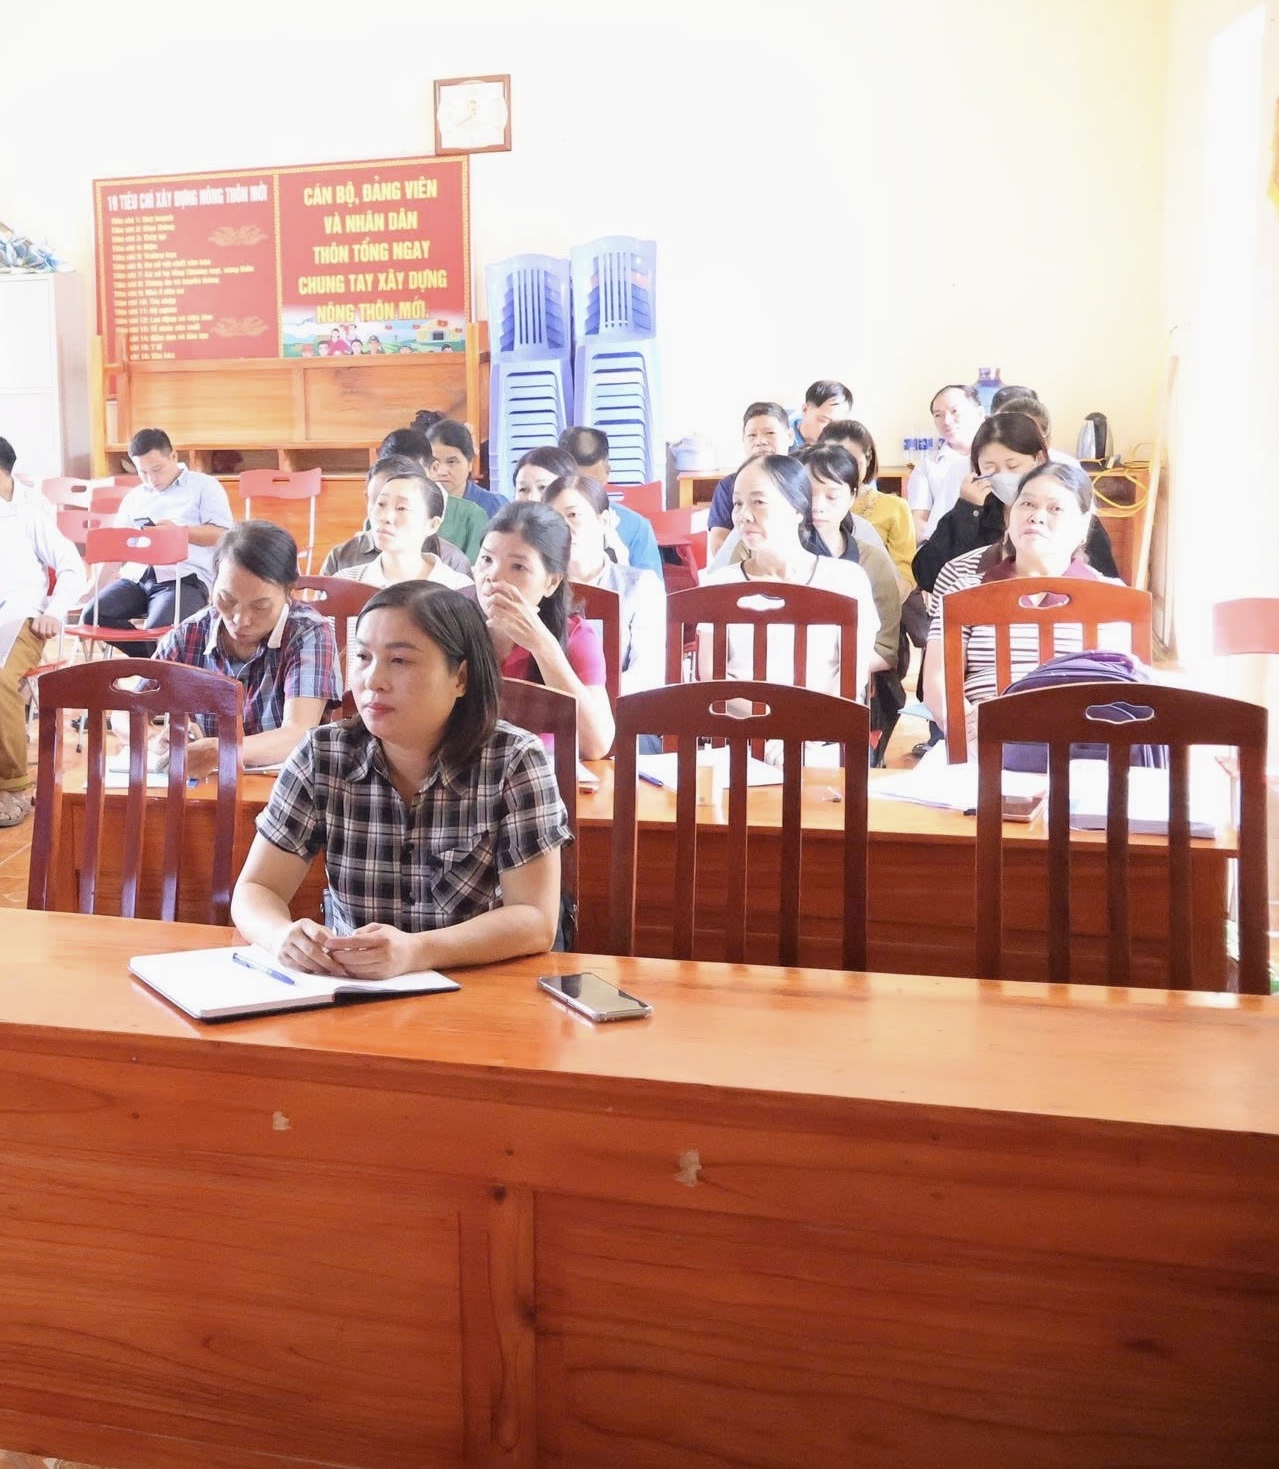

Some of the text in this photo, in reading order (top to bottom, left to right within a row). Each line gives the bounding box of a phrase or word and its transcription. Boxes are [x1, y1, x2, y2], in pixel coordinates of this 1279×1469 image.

[107, 194, 118, 211] 19
[303, 175, 438, 207] CÁN BỘ, ĐẢNG VIÊN
[324, 207, 418, 234] VÀ NHÂN DÂN
[313, 241, 349, 265] THÔN
[392, 240, 431, 260] NGAY
[298, 268, 447, 295] CHUNG TAY XÂY DỰNG
[316, 301, 355, 324] NÔNG
[358, 299, 395, 322] THÔN
